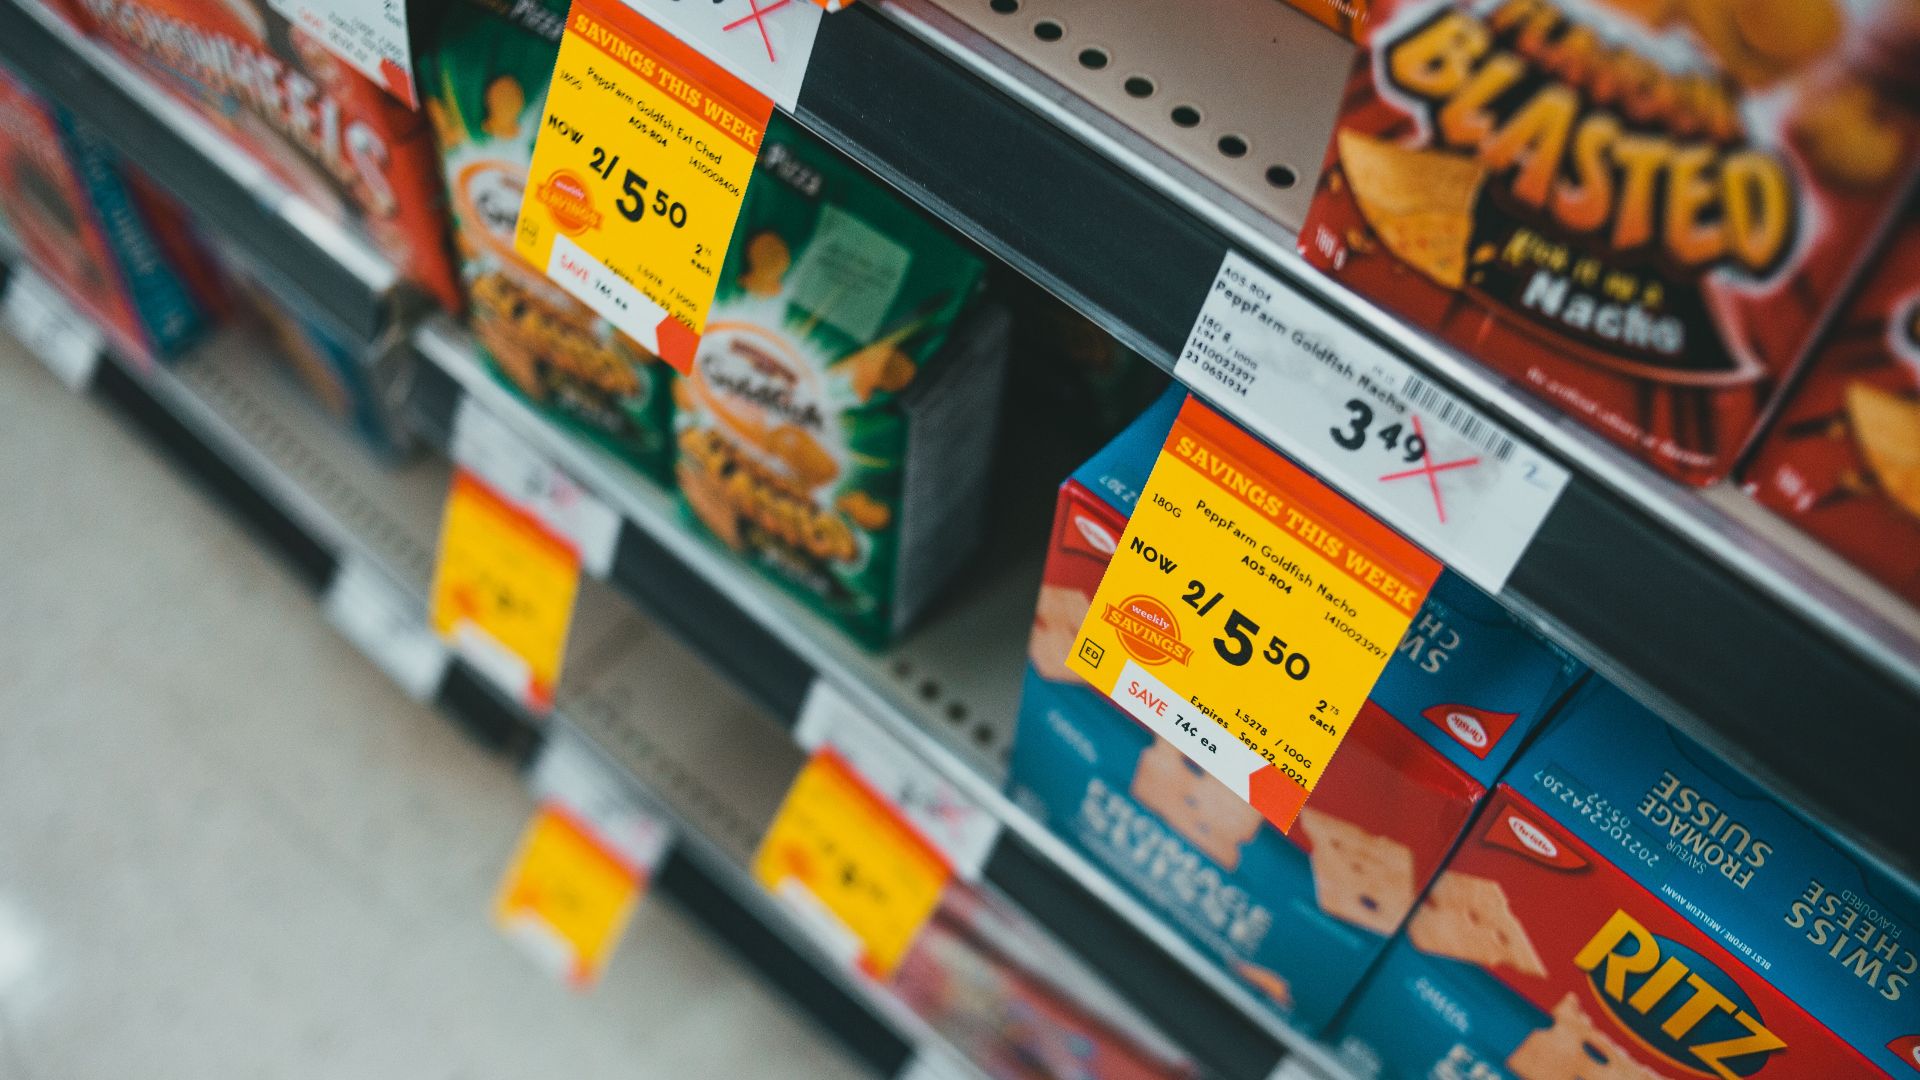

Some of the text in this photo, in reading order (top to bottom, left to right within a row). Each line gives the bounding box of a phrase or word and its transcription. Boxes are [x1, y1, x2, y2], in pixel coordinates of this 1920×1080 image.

[574, 14, 759, 148] SAVINGS THIS WEEK
[547, 113, 585, 146] NOW
[694, 139, 723, 165] Ched
[1388, 10, 1790, 270] BLASTED
[1215, 280, 1287, 335] PeppFarm
[1184, 350, 1248, 397] 23 0651934
[1191, 337, 1256, 385] 1410023297
[1330, 398, 1373, 451] 3
[1152, 492, 1182, 519] 180G
[1174, 435, 1419, 613] SAVINGS THIS WEEK
[1129, 535, 1178, 576] NOW
[1195, 499, 1358, 619] PeppFarm Goldfish Nacho
[1240, 555, 1293, 595] A05-R04
[1108, 610, 1185, 660] SAVINGS
[1131, 604, 1170, 630] weekly
[1181, 580, 1311, 682] 2/ 5 50
[1323, 611, 1388, 661] 1410023297
[1084, 645, 1100, 661] ED
[1127, 680, 1218, 755] SAVE 74¢ ea
[1189, 695, 1309, 789] Expires Sep 22, 2021
[1234, 707, 1269, 738] 1.5278
[1308, 712, 1338, 737] each
[1637, 794, 1756, 890] FROMAGE
[1651, 770, 1774, 868] SUISSE
[1665, 839, 1708, 875] SAVEUR
[1660, 883, 1690, 906] AVANT
[1689, 902, 1722, 934] MEILLEUR
[1841, 888, 1904, 940] FLAVOURED
[1722, 929, 1753, 956] BEFORE
[1783, 901, 1910, 1001] SWISS
[1802, 880, 1919, 975] CHEESE
[1748, 951, 1773, 971] BEST
[1572, 908, 1789, 1080] RITZ
